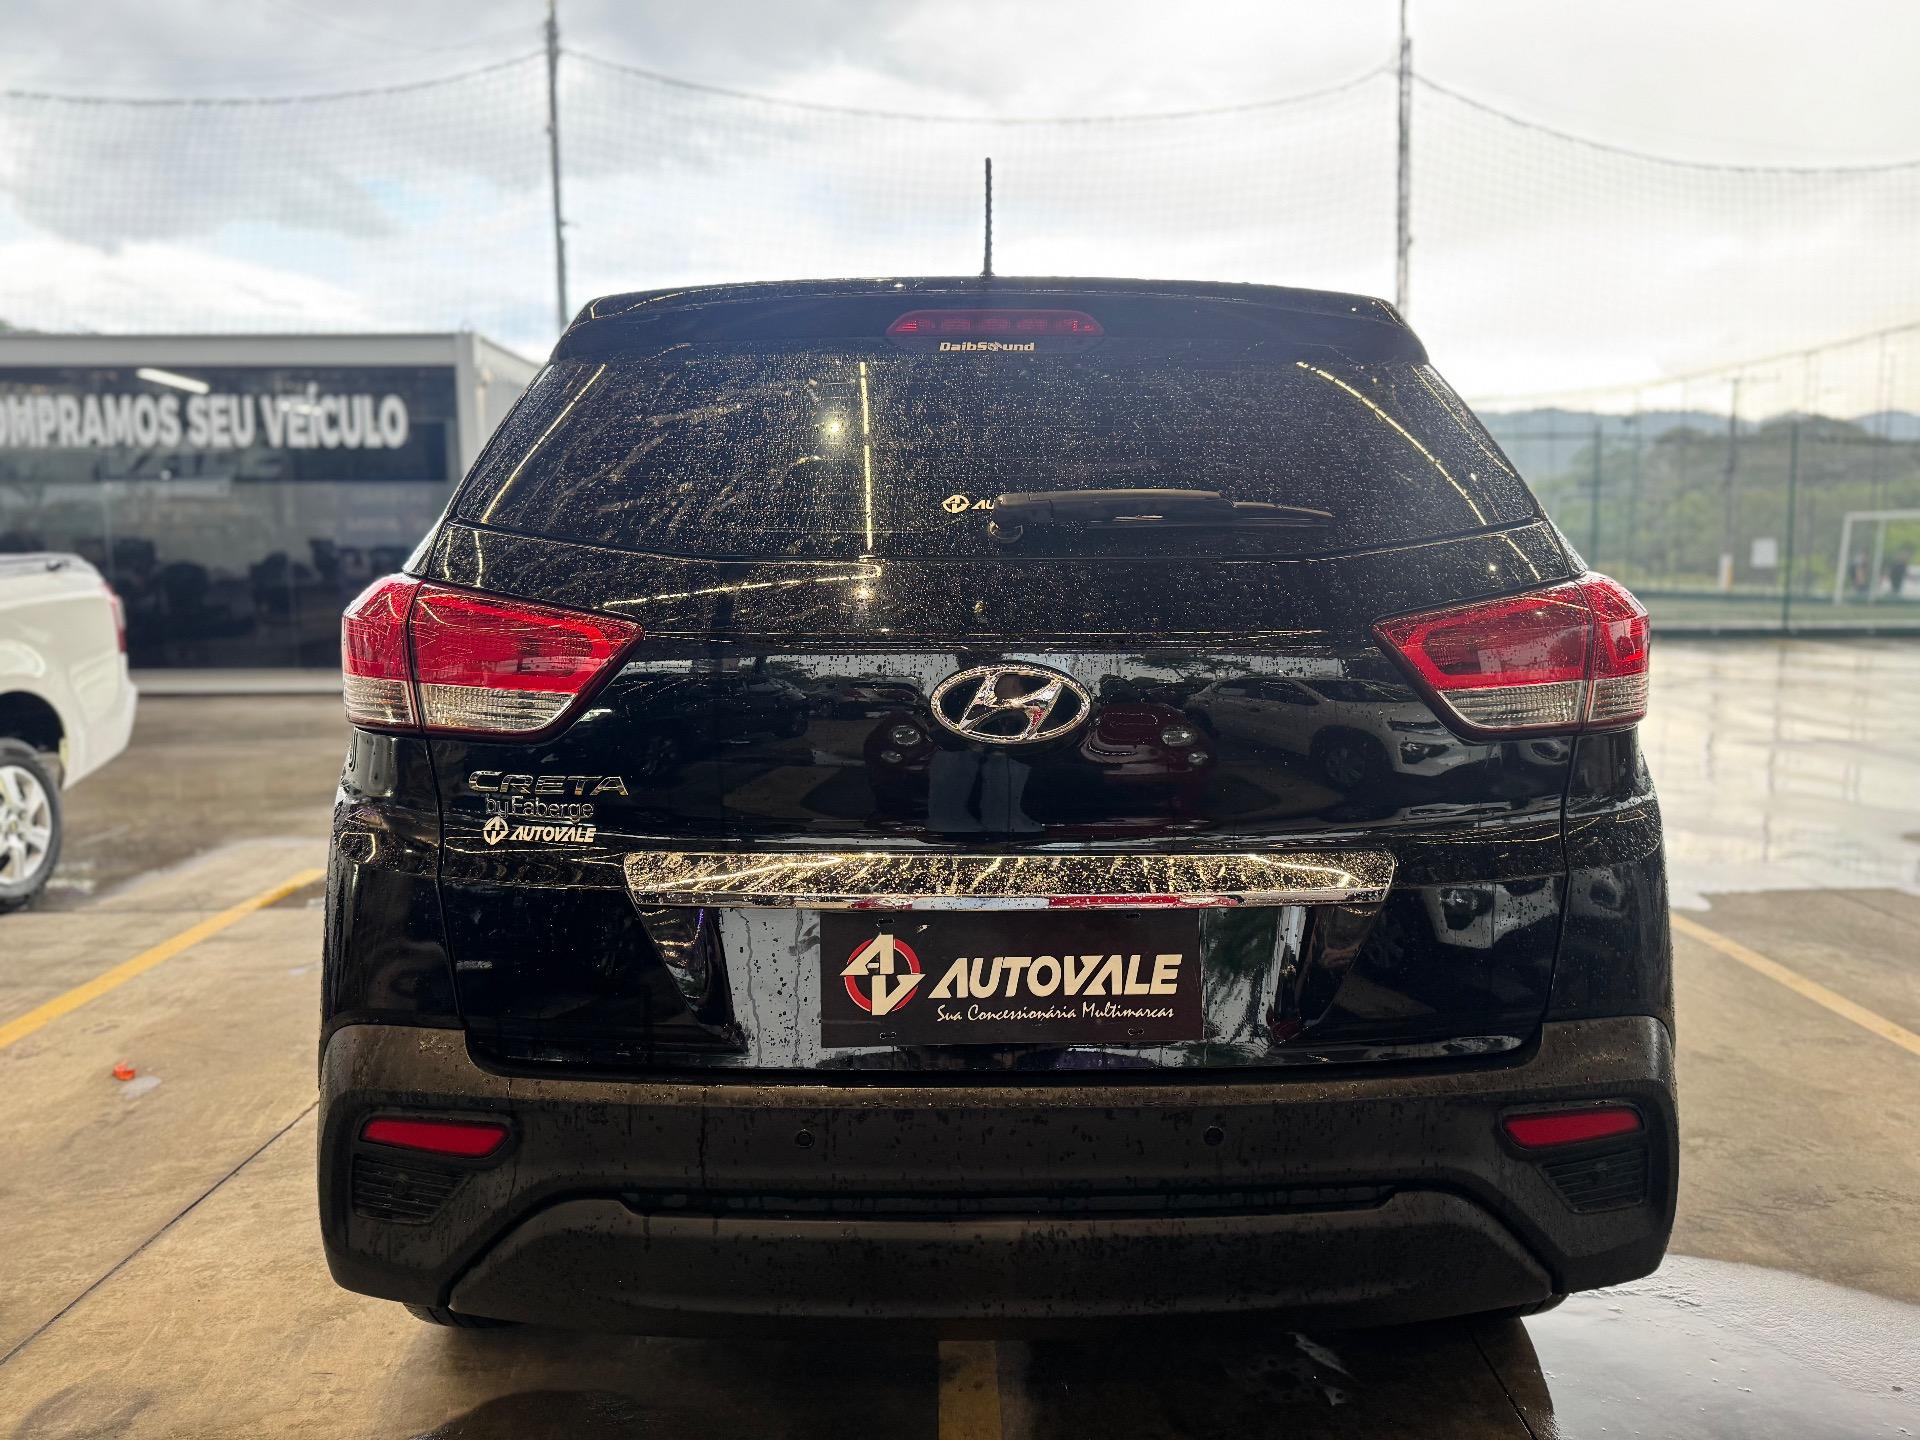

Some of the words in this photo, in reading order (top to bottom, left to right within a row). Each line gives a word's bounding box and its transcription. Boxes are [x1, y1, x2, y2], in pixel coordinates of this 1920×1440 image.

[187, 393, 256, 448] SEU
[262, 381, 409, 448] VEÍCULO
[468, 770, 629, 796] CRETA
[485, 794, 508, 818] by
[511, 795, 594, 823] Faberge
[510, 825, 597, 843] AUTOVALE
[927, 953, 1183, 999] AUTOVALE
[936, 1004, 962, 1022] Sua
[967, 1004, 1076, 1022] Concessionária
[1082, 1001, 1175, 1019] Multimarcas
